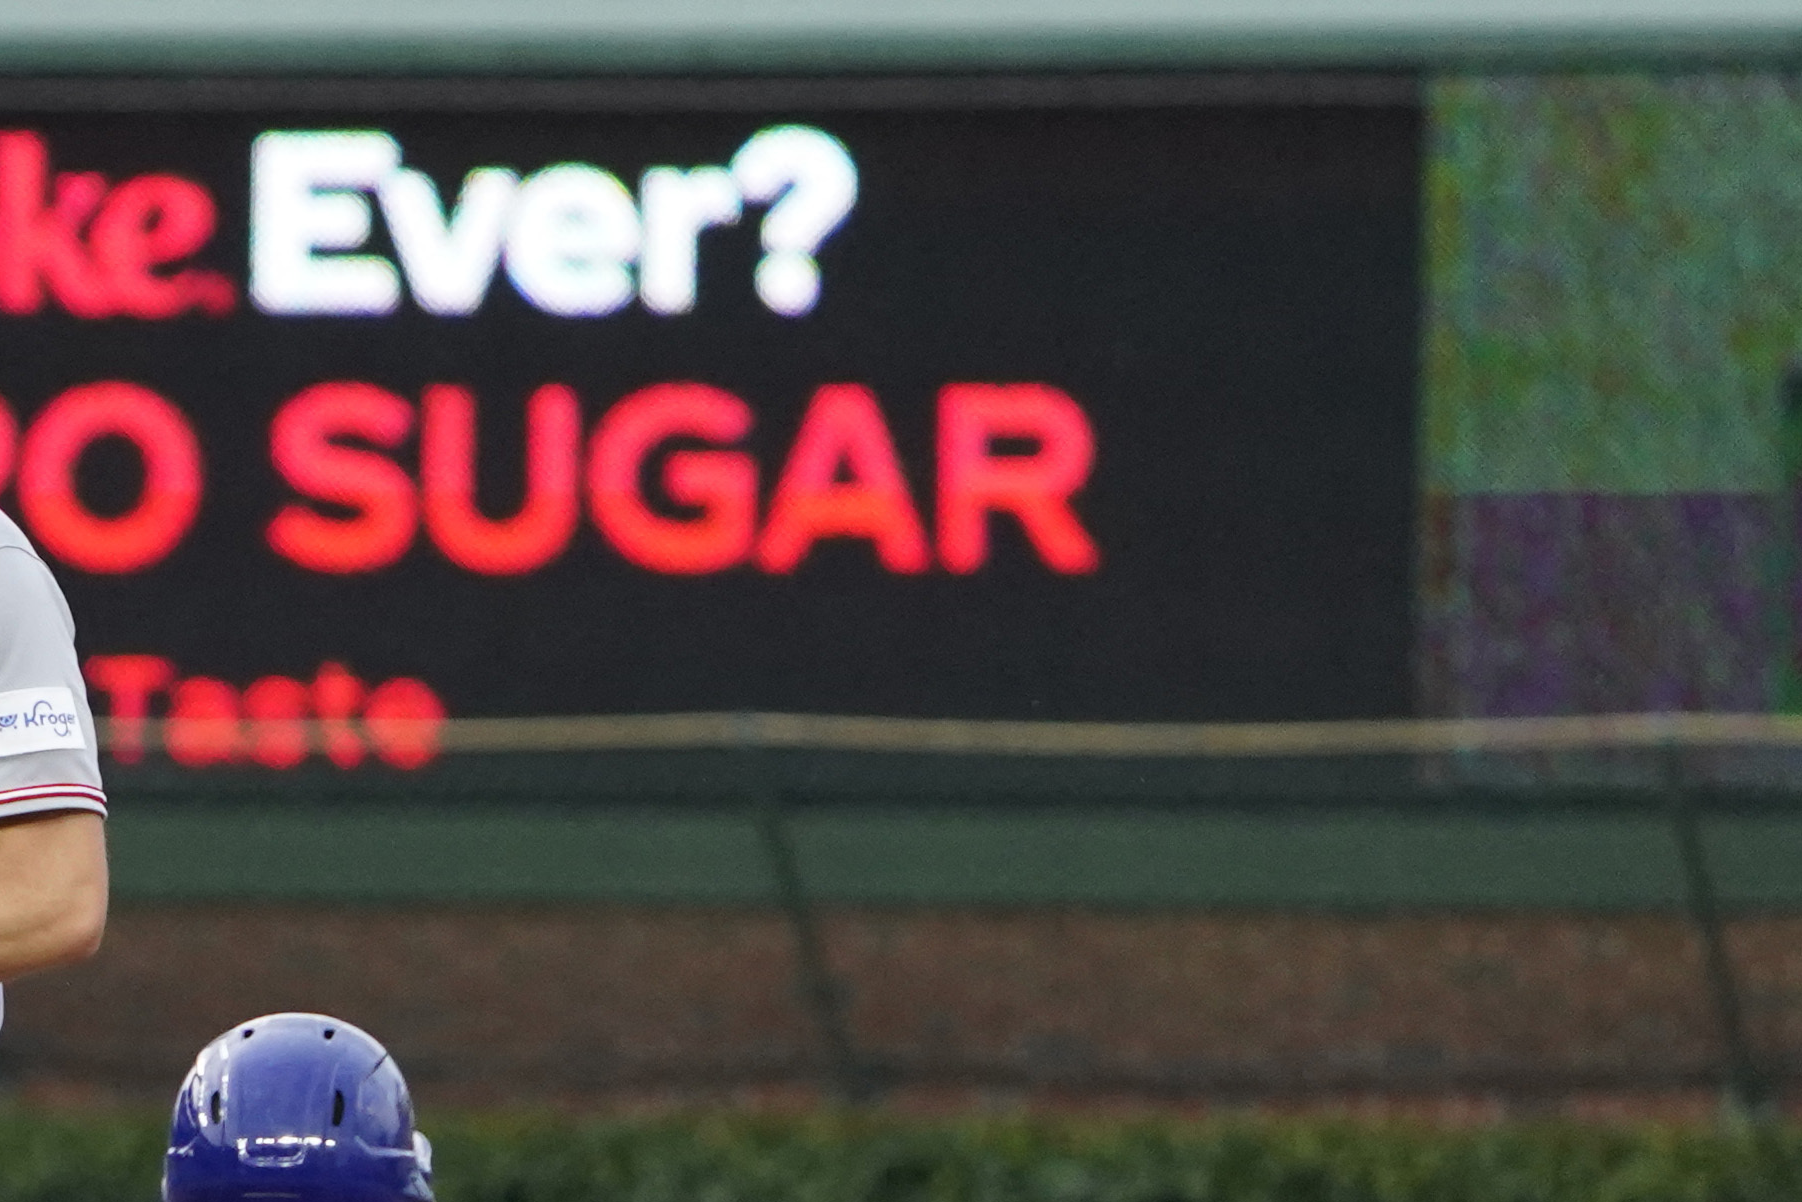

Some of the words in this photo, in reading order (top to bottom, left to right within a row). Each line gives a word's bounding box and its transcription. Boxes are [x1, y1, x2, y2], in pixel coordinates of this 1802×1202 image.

[250, 125, 858, 317] Ever?
[266, 380, 1099, 576] SUGAR
[24, 700, 75, 737] Kroge
